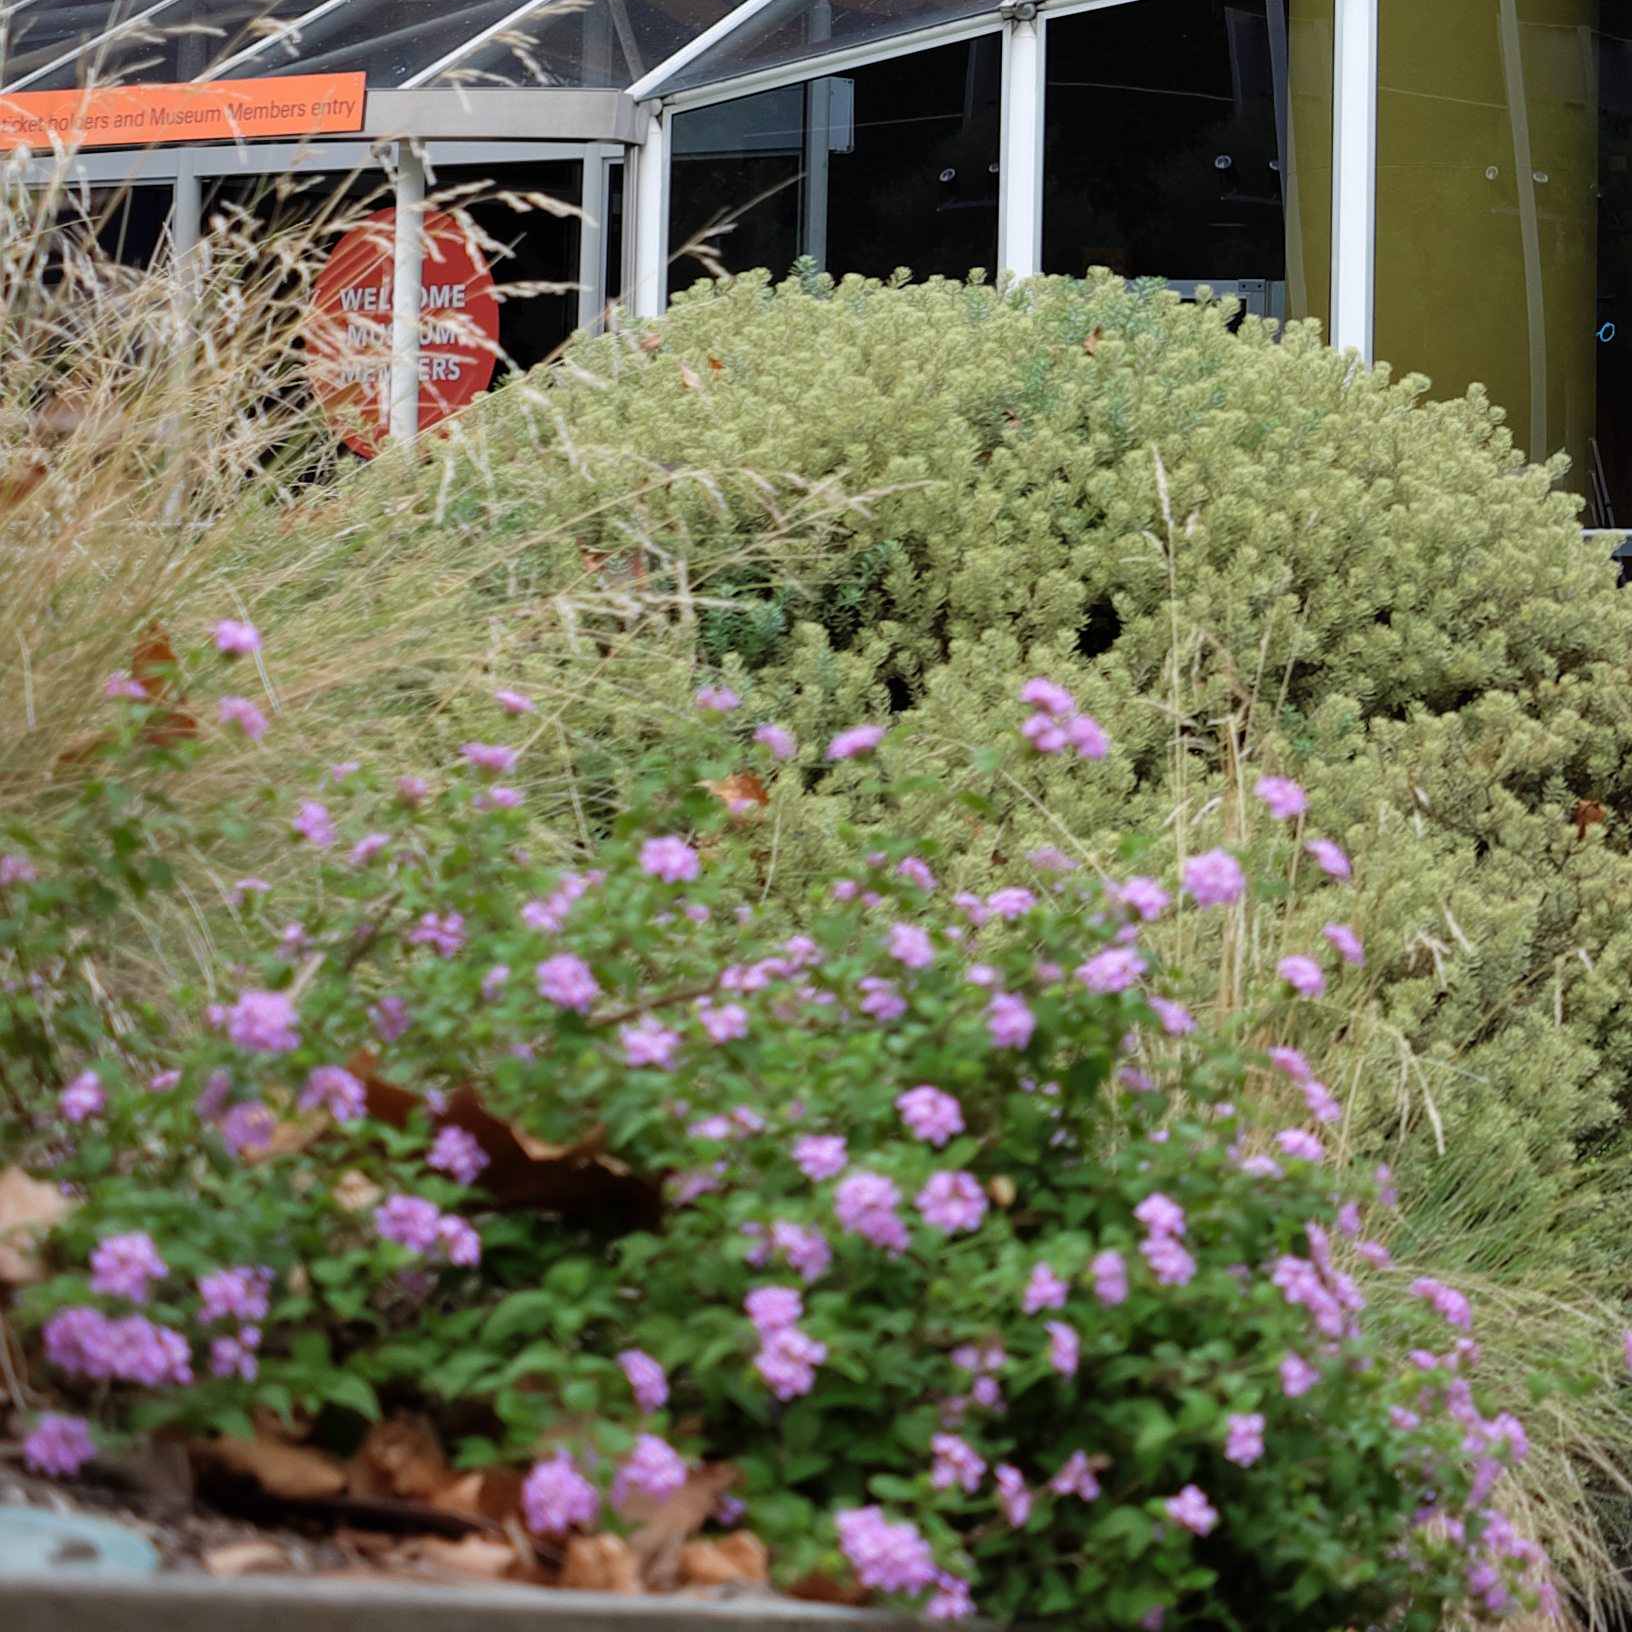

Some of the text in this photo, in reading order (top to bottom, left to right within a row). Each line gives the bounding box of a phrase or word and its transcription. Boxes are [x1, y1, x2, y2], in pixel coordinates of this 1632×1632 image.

[114, 110, 145, 129] and
[150, 106, 221, 125] Museum
[227, 100, 306, 121] Members
[311, 99, 356, 118] entry
